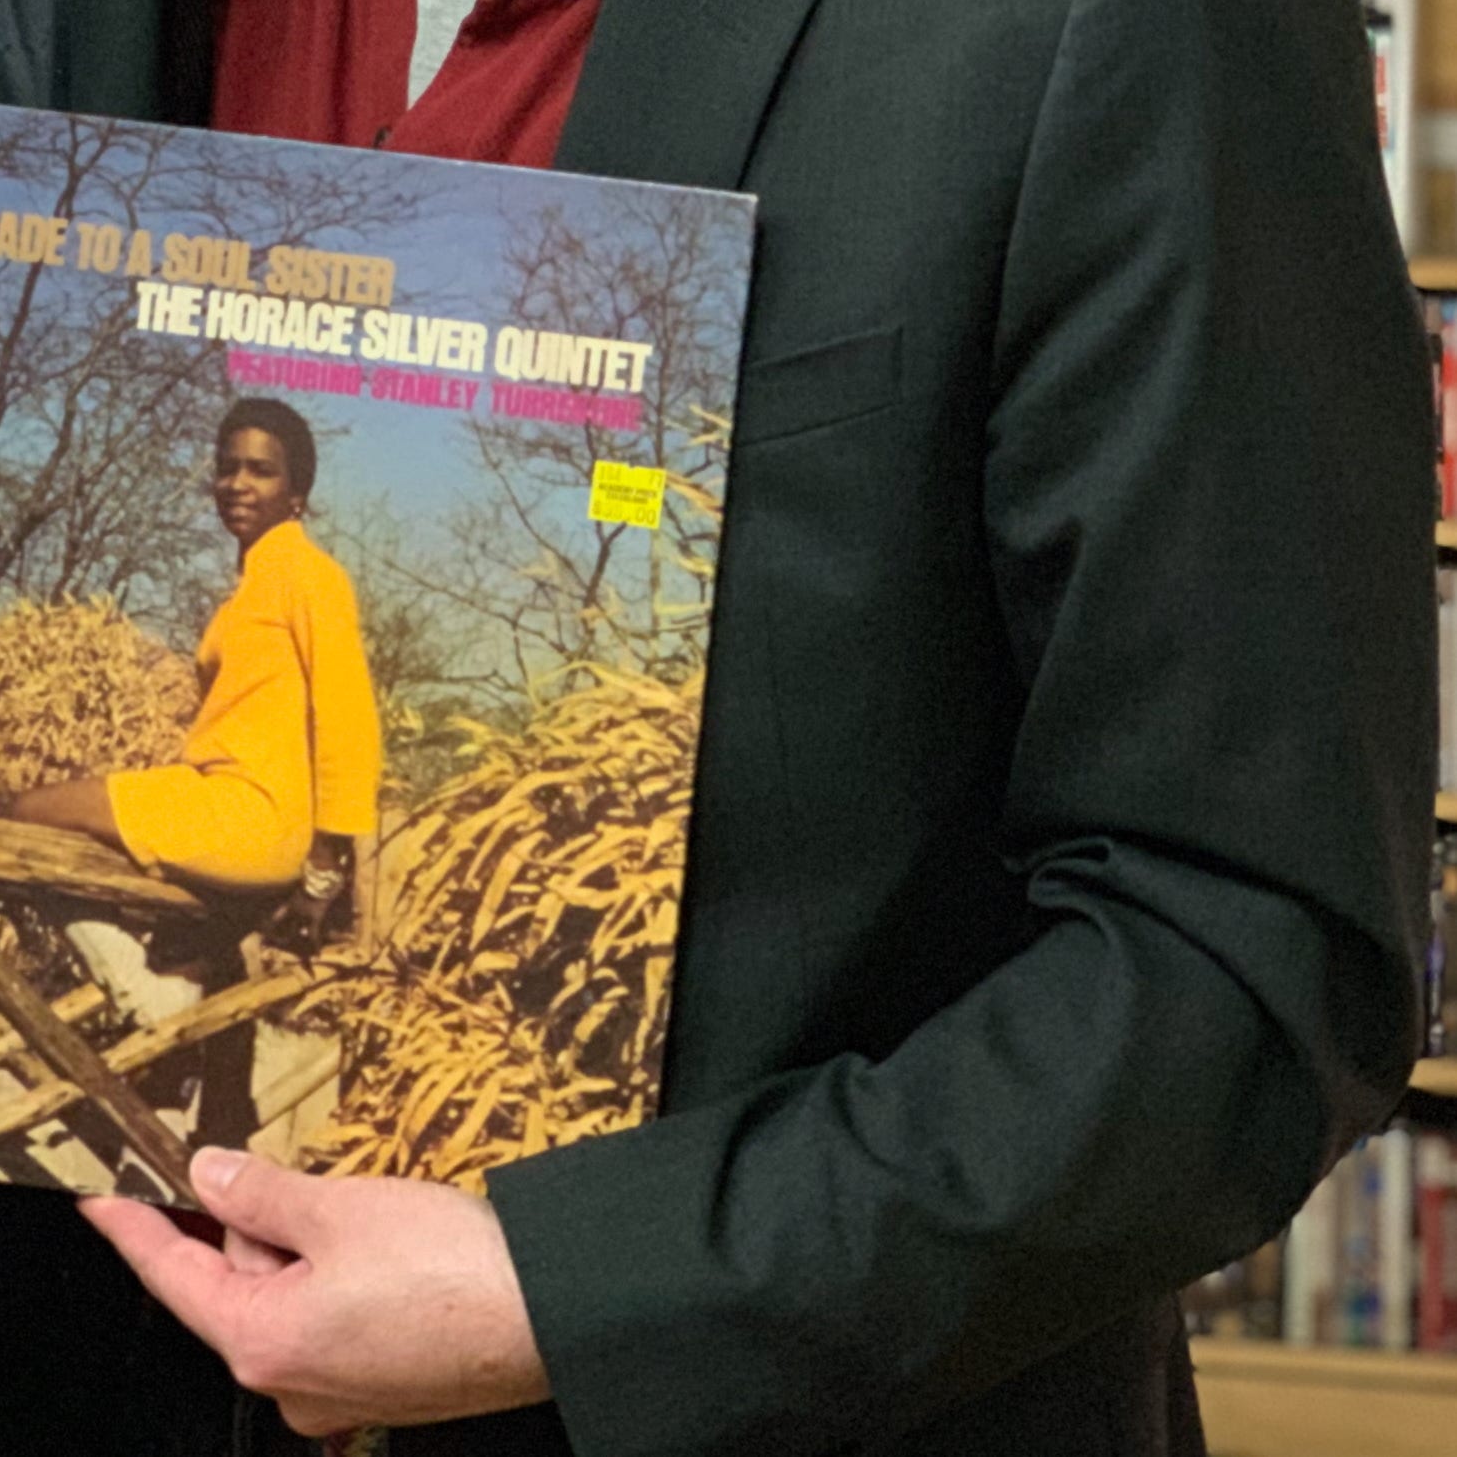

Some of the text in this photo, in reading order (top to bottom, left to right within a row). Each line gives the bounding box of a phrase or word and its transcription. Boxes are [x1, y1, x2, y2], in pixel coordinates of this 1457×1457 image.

[77, 222, 121, 273] TO
[124, 229, 152, 278] A
[161, 232, 256, 291] SOUL
[266, 244, 396, 307] SISTER
[136, 281, 653, 393] THE HORACE SILVER QUINTET
[228, 349, 363, 397] FEATURING
[371, 365, 480, 412] STANLEY
